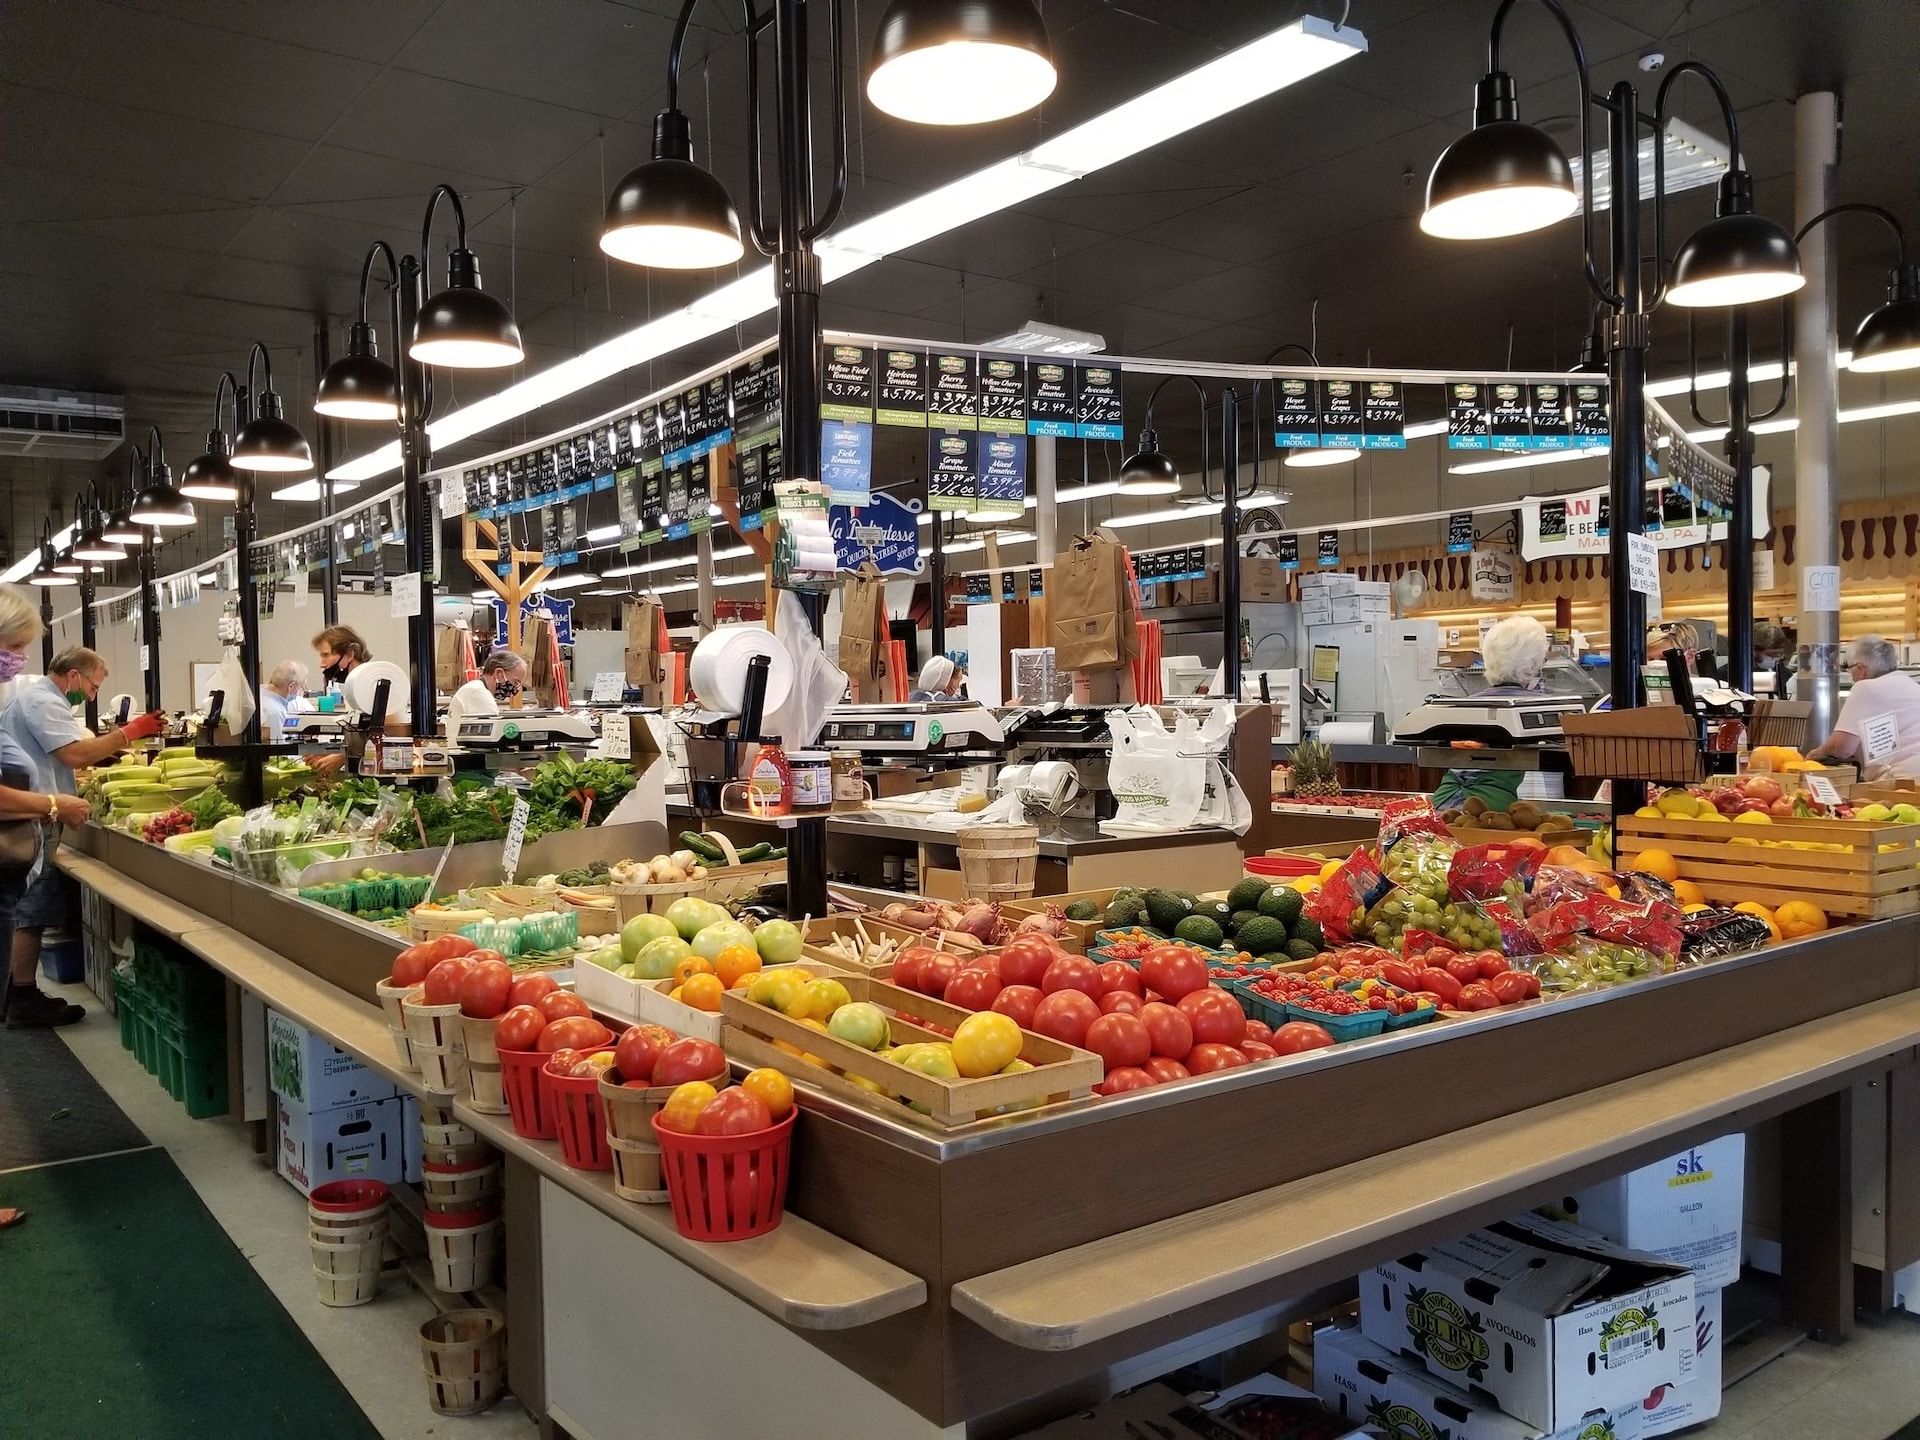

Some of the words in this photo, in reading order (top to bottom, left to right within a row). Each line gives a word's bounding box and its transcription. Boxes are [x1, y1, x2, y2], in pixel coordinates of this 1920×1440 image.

[828, 364, 850, 373] Yellow
[852, 366, 870, 374] Field
[832, 372, 864, 381] Tomatoes
[886, 370, 917, 380] Heirloom
[940, 374, 964, 384] Cherry
[886, 376, 917, 386] Tomatoes
[938, 380, 968, 390] Tomatoes
[982, 378, 1000, 386] Yellow
[1001, 380, 1022, 390] Cherry
[988, 386, 1016, 394] Tomatoes
[1042, 383, 1062, 391] Roma
[1084, 386, 1114, 395] Avocados
[1037, 390, 1066, 398] Tomatoes
[1330, 404, 1351, 412] Grapes
[1379, 399, 1400, 408] Grapes
[1494, 406, 1523, 415] Grapefruit
[1538, 407, 1560, 415] Oranges
[1036, 428, 1067, 436] PRODUCE
[1085, 430, 1116, 438] PRODUCE
[838, 449, 856, 458] Field
[831, 456, 862, 464] Tomatoes
[943, 456, 964, 465] Grape
[992, 460, 1014, 468] Mixed
[938, 463, 968, 472] Tomatoes
[988, 466, 1017, 475] Tomatoes
[896, 544, 916, 562] SOUPS
[333, 1065, 350, 1074] GREEN
[355, 1108, 366, 1120] BU
[1676, 1149, 1704, 1176] sk
[1680, 1202, 1703, 1214] GALLEON
[1376, 1266, 1397, 1282] HASS
[1426, 1298, 1464, 1326] AVOCADO
[1578, 1326, 1594, 1336] Hass
[1662, 1294, 1688, 1308] Avocados
[1615, 1310, 1643, 1331] AVOCADO
[1416, 1310, 1443, 1336] DEL
[1450, 1324, 1476, 1352] REY
[1485, 1317, 1537, 1348] AVOCADOS
[1427, 1336, 1467, 1367] COMPANY
[1334, 1373, 1358, 1393] HASS
